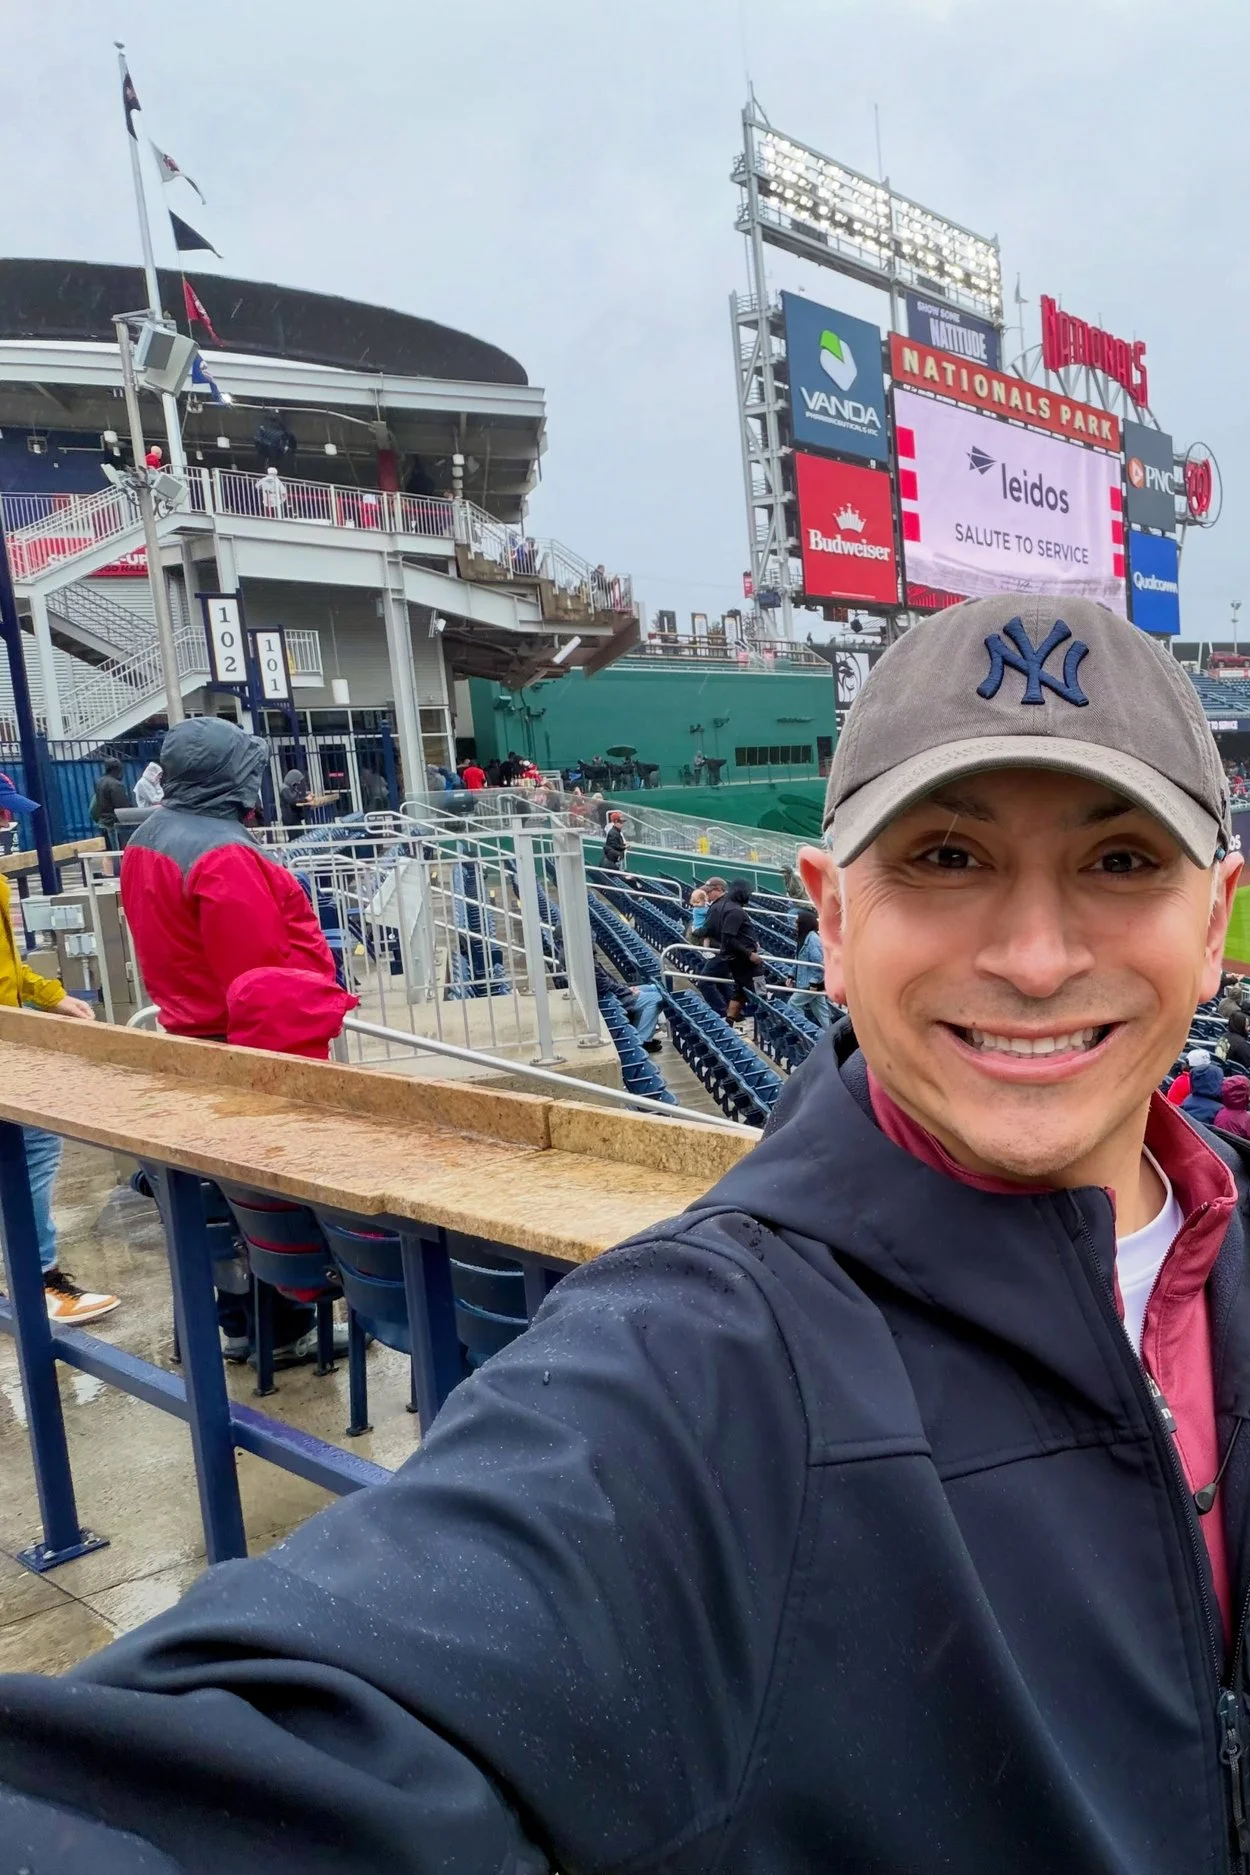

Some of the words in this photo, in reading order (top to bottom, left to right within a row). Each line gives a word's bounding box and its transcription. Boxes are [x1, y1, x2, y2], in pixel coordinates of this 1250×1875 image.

[930, 317, 988, 361] NATITUDE
[1040, 294, 1148, 408] NATIONALS
[800, 386, 882, 429] VANDA
[902, 347, 1051, 420] NATIONALS
[1059, 404, 1113, 441] PARK
[1002, 462, 1070, 514] leidos
[1144, 464, 1176, 495] PNC
[807, 528, 891, 562] Budweiser
[954, 522, 1011, 551] SALUTE
[1016, 535, 1034, 554] TO
[1037, 539, 1089, 565] SERVICE
[1133, 571, 1178, 595] Qualcomm
[218, 606, 238, 673] 102
[976, 615, 1090, 708] NY
[264, 639, 281, 692] 101
